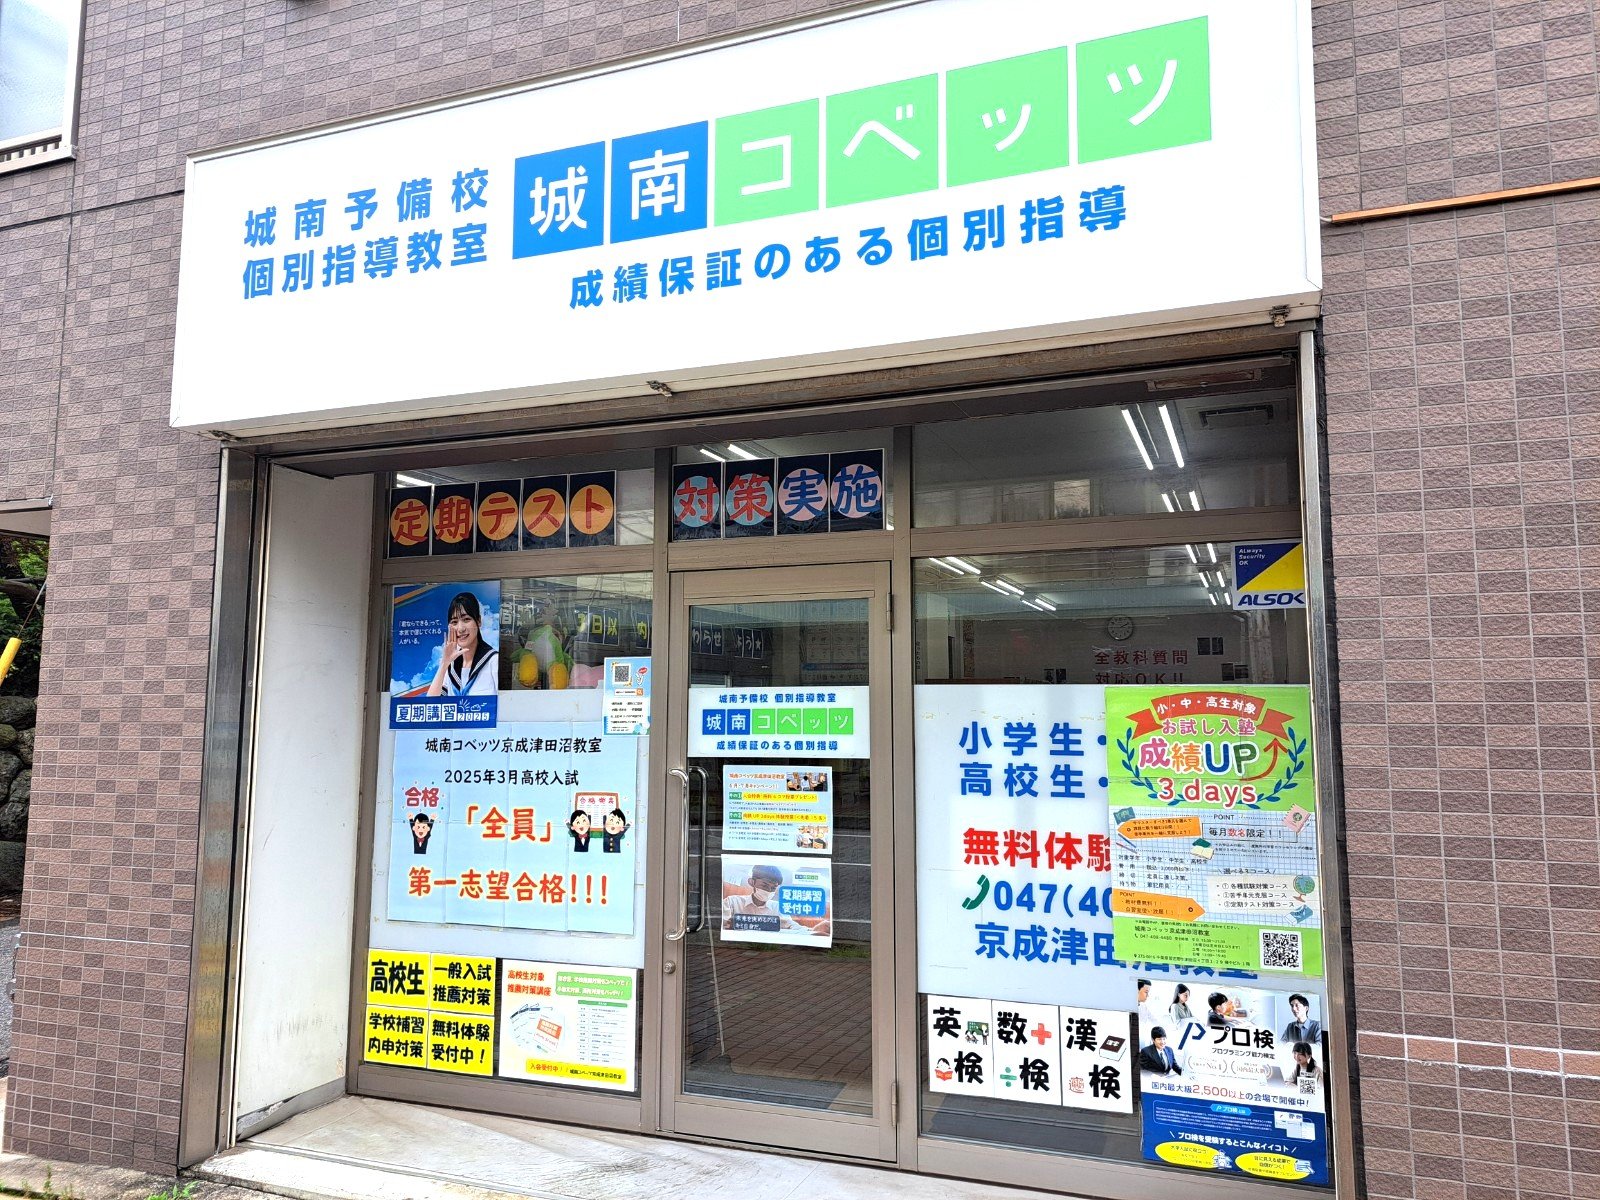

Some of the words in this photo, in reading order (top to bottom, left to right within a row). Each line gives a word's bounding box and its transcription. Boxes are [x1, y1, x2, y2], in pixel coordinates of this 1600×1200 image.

[529, 58, 1180, 237] 城南コベッツ
[244, 167, 490, 248] 城南予備校
[570, 184, 1127, 308] 成績保証のある個別指導
[242, 223, 488, 299] 個別指導教室
[674, 465, 880, 522] 対策実施
[393, 488, 606, 545] 定期テスト
[1238, 593, 1305, 606] ALSOK
[1095, 650, 1188, 665] 全教科質問
[719, 694, 769, 704] 城南予備校
[775, 693, 837, 703] 個別指導教室
[1157, 696, 1257, 715] 小・中・高生対象
[396, 704, 457, 722] 夏期講習
[458, 713, 490, 722] 2025
[706, 713, 849, 731] 城南コベッツ
[1162, 718, 1256, 736] お試し入塾
[425, 737, 602, 754] 城南コベッツ京成津田沼教室
[716, 740, 839, 751] 成績保証のある個別指導
[959, 721, 1107, 757] 小学生・
[1139, 738, 1257, 774] 成績UP
[444, 769, 579, 787] 2025年3月高校入試
[959, 762, 1109, 798] 高校生・
[405, 787, 440, 808] 合格
[1159, 778, 1175, 801] 3
[1184, 778, 1257, 808] days
[466, 806, 551, 843] 「全員」
[408, 867, 608, 905] 第一志望合格!!!
[782, 889, 823, 902] 夏期講習
[782, 902, 820, 915] 受付中！
[370, 959, 425, 996] 高校生
[433, 961, 492, 982] 一般入試
[507, 969, 545, 982] 高校生対象
[432, 984, 491, 1006] 推薦対策
[368, 1012, 425, 1035] 学校補習
[432, 1018, 491, 1042] 無料体験
[368, 1036, 424, 1059] 内申対策
[933, 1006, 984, 1084] 英検
[1210, 1025, 1275, 1050] プロ検
[431, 1043, 485, 1065] 受付中！
[997, 1011, 1050, 1092] 数検
[1066, 1017, 1121, 1100] 漢検
[1211, 1047, 1275, 1060] プログラミング能力検定
[1178, 1131, 1289, 1153] プロ検を受験するとこんなイイコト
